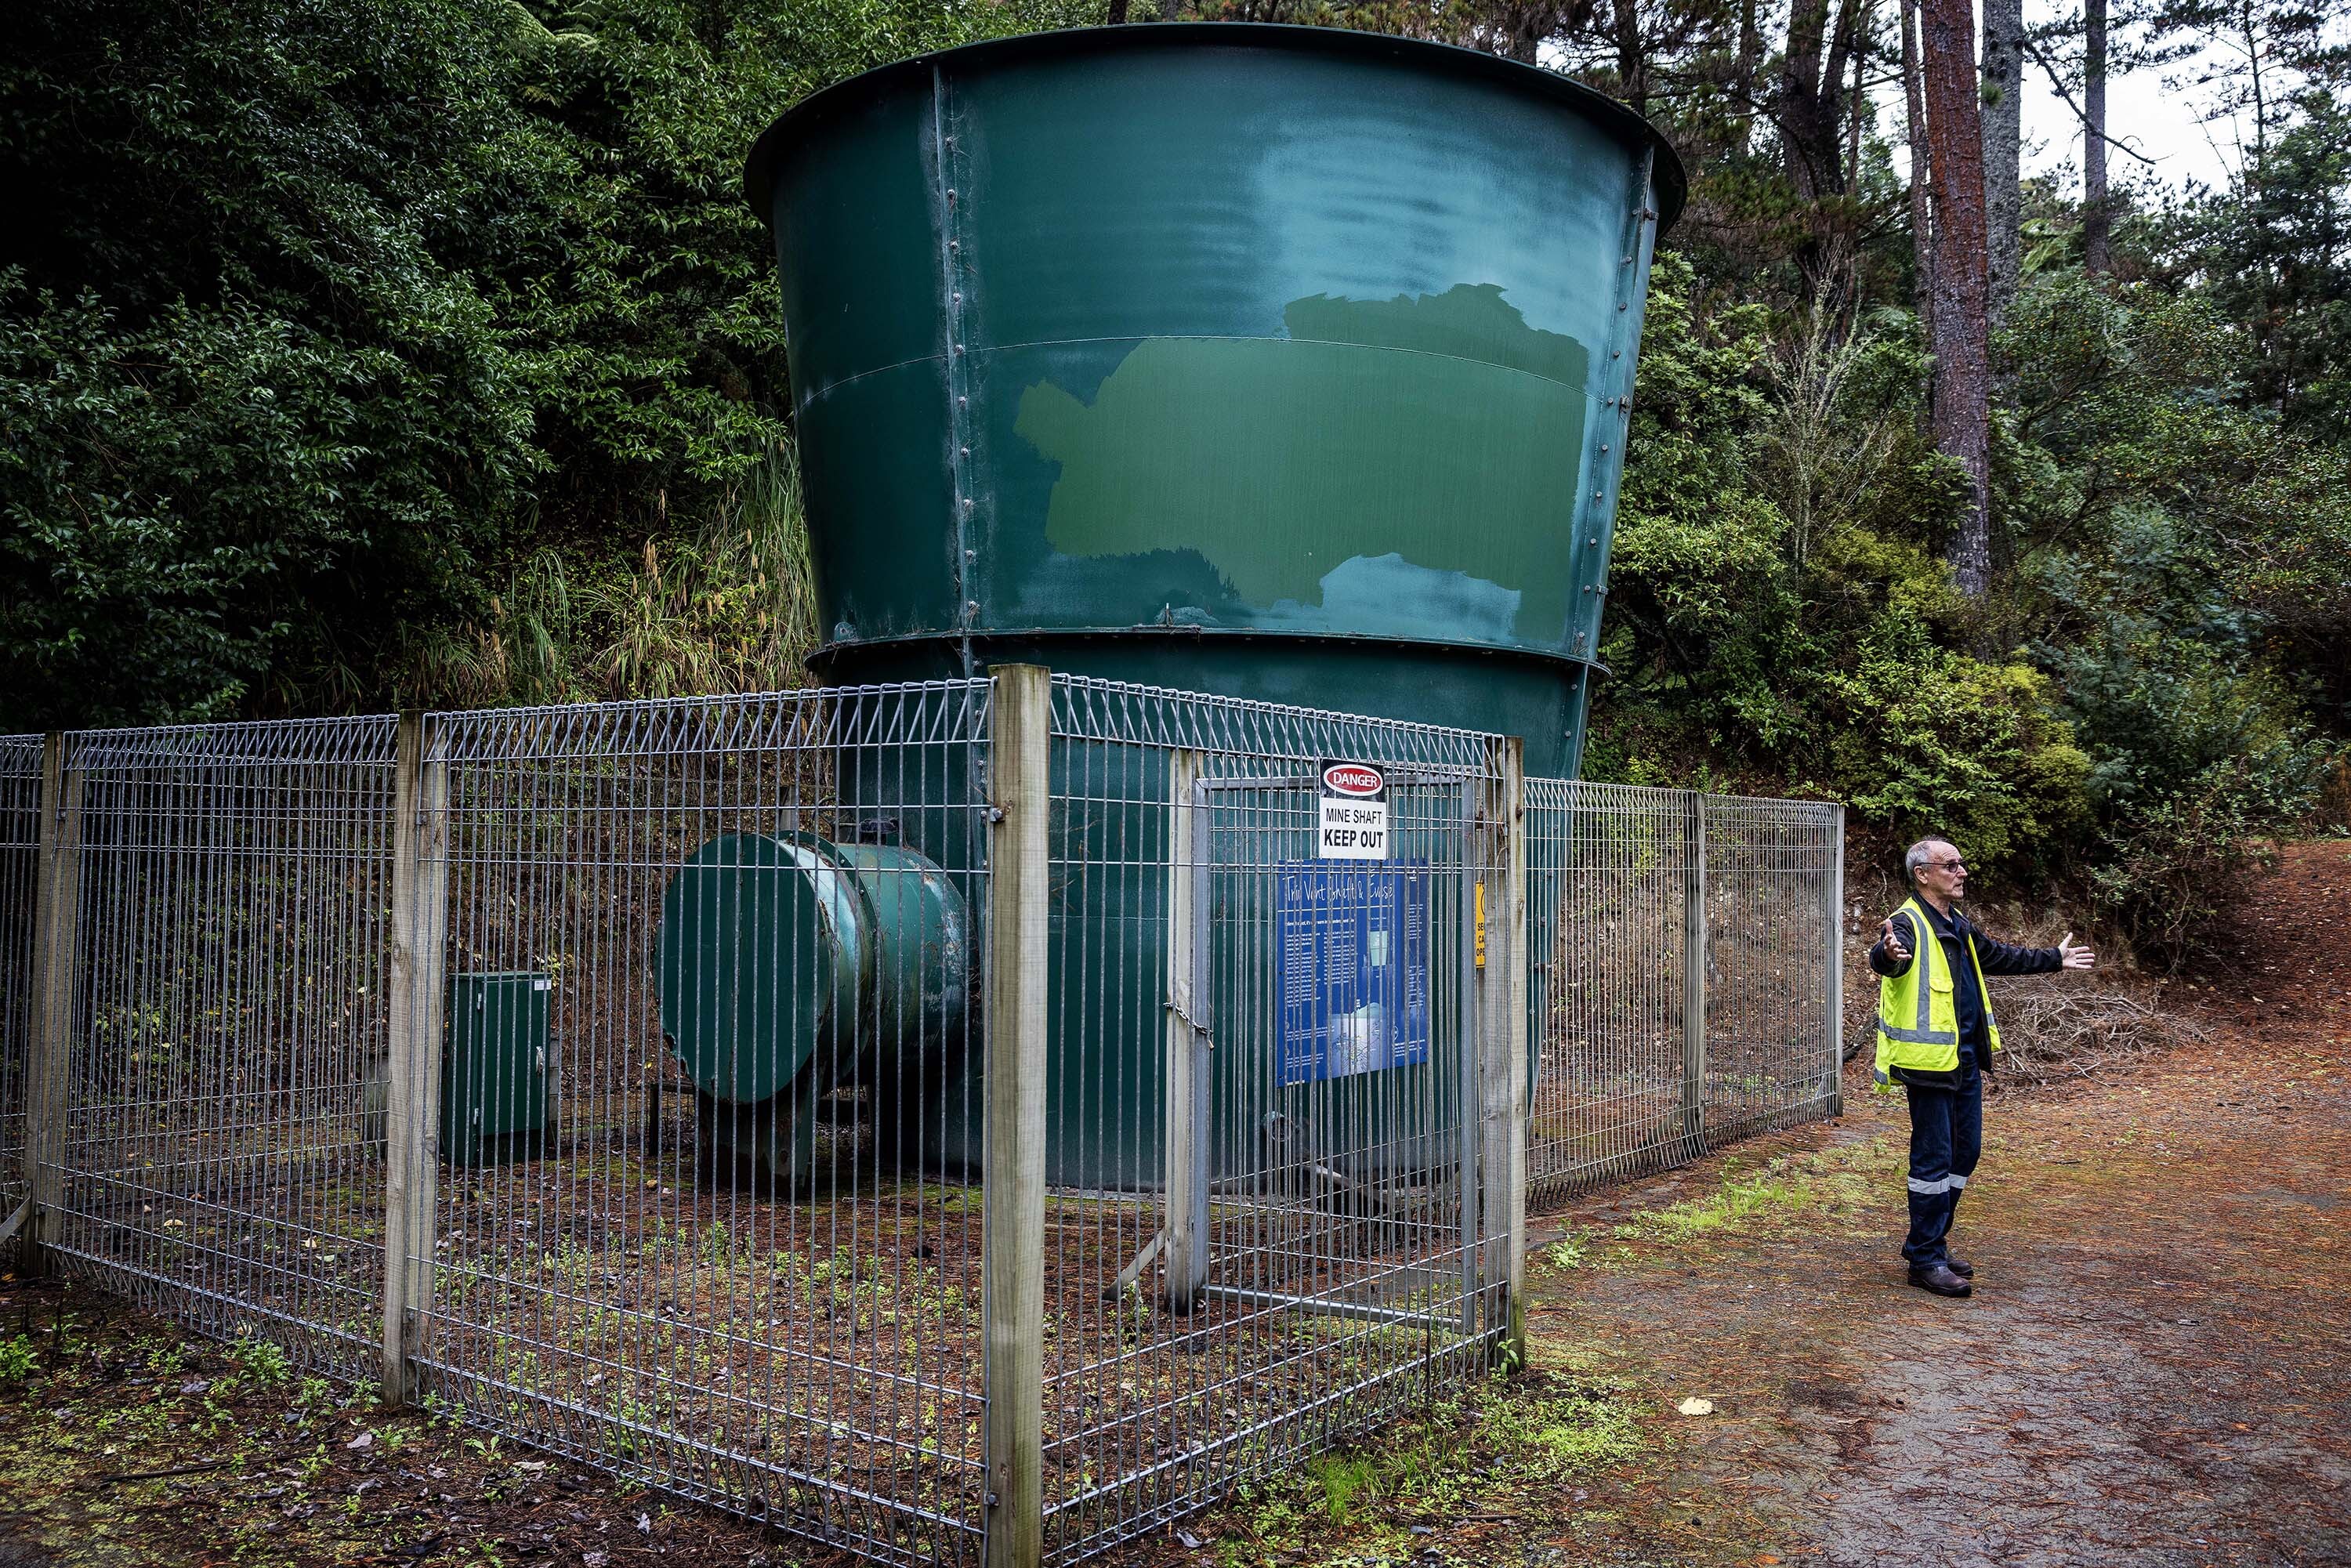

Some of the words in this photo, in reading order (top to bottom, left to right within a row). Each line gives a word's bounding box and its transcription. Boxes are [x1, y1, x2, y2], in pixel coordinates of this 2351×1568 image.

[1333, 772, 1378, 788] DANGER
[1326, 808, 1350, 823] MINE
[1353, 809, 1382, 824] SHAFT
[1324, 829, 1357, 847] KEEP
[1360, 831, 1383, 848] OUT
[1357, 880, 1364, 900] &
